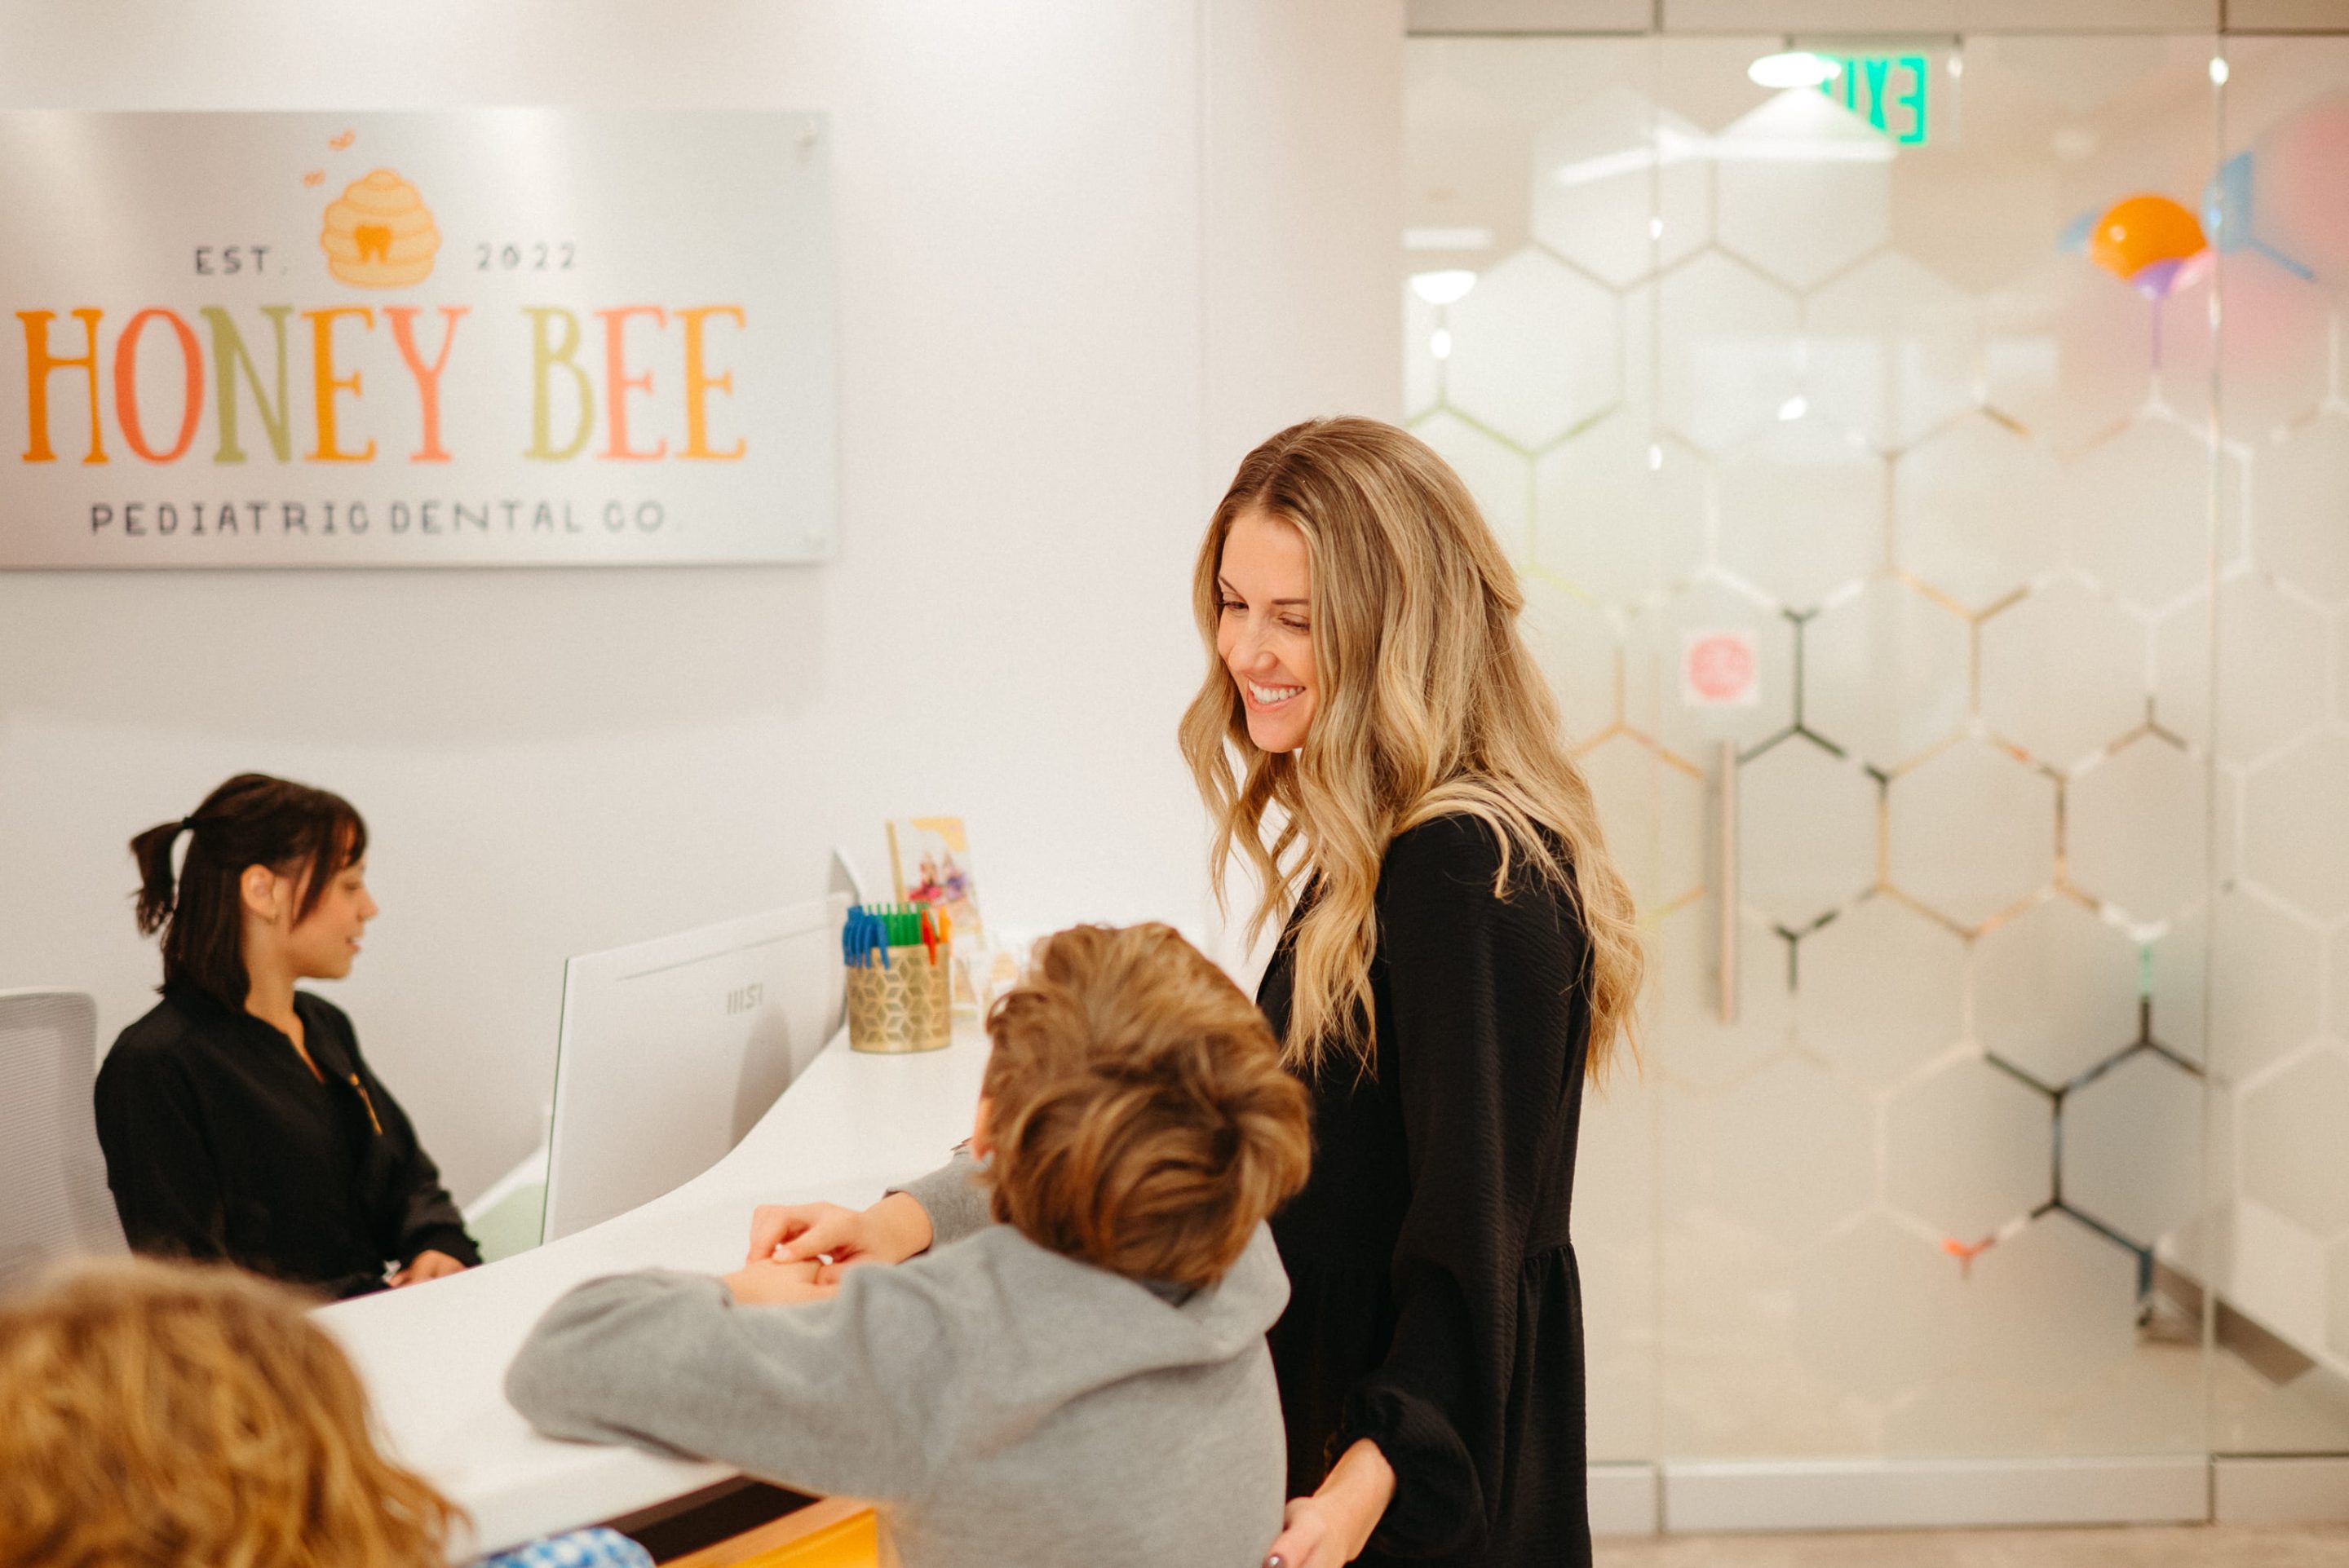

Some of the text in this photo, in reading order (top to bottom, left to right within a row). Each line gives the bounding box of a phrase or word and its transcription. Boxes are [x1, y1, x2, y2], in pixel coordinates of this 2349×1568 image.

[476, 244, 576, 270] 2022
[16, 305, 747, 465] HONEY BEE
[91, 501, 369, 536] PEDIATRIC
[391, 499, 584, 534] DENTAL
